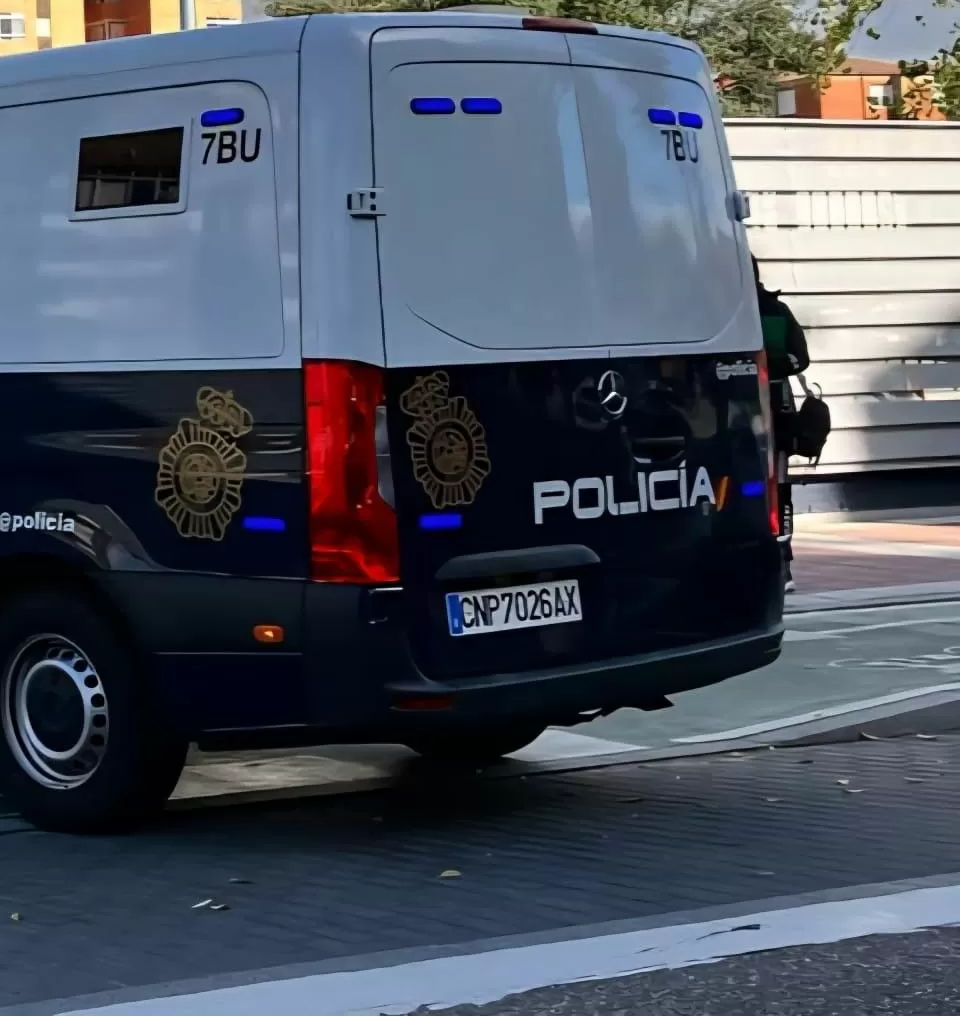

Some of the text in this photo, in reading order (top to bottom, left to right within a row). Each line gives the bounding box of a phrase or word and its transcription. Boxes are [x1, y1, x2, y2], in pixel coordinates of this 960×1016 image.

[200, 128, 261, 165] 7BU
[660, 129, 699, 164] 7BU
[533, 458, 716, 525] POLICÍA
[460, 585, 579, 628] CNP7026AX
